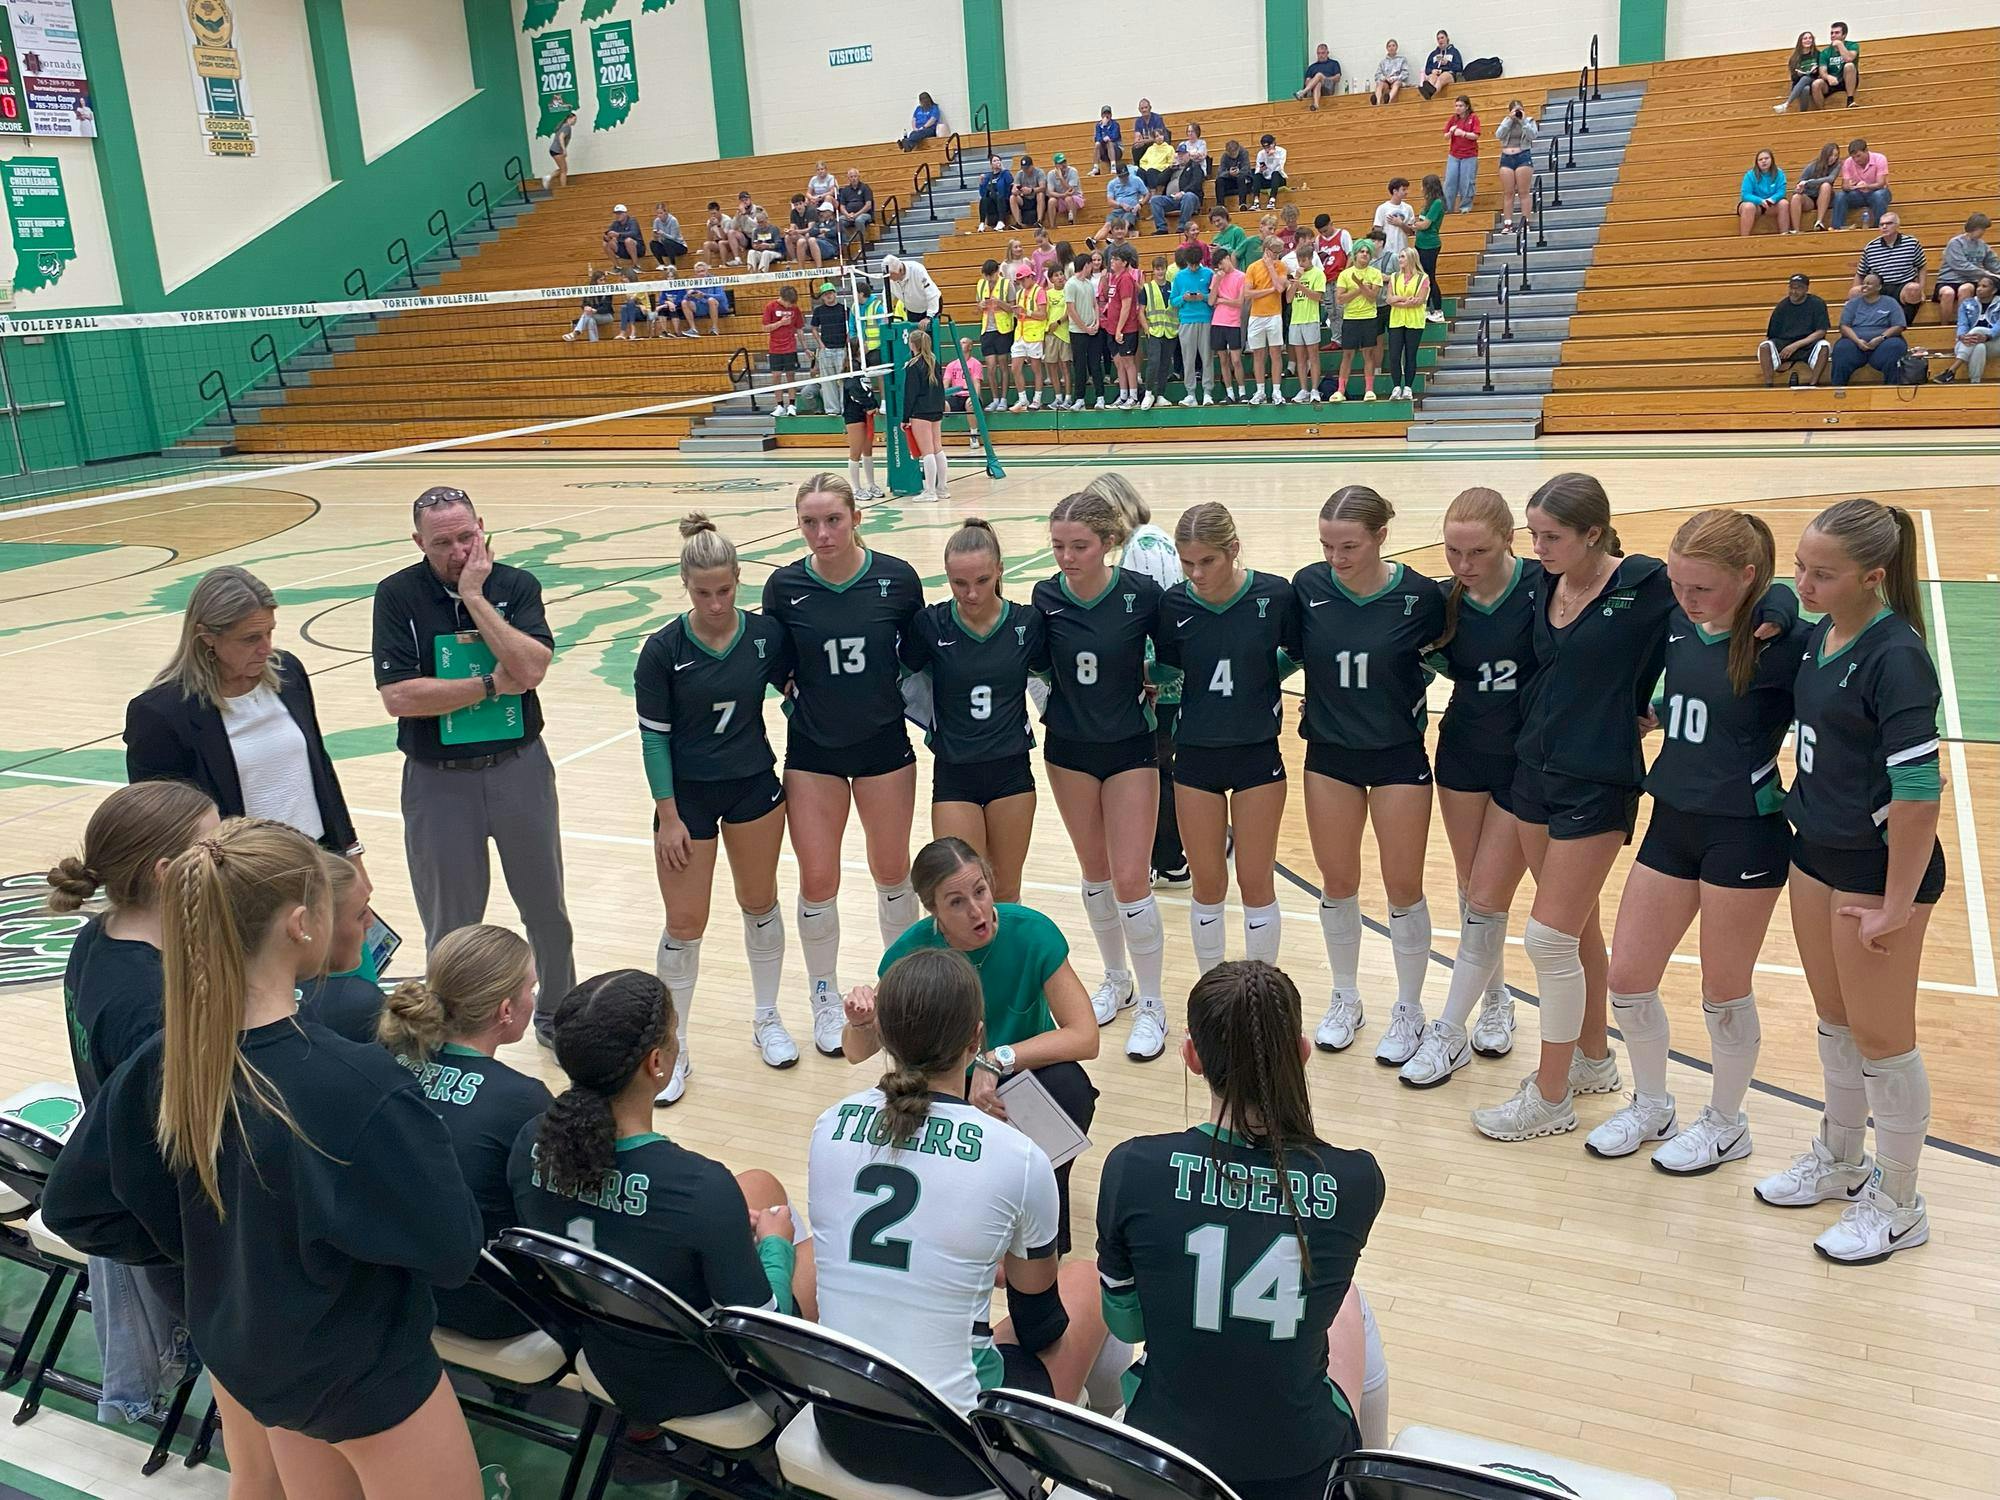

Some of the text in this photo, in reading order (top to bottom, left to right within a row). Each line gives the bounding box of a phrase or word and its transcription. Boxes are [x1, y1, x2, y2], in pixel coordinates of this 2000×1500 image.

[830, 46, 872, 65] VISITORS
[542, 72, 572, 92] 2022
[600, 63, 632, 84] 2024
[2, 96, 16, 118] 0
[0, 122, 24, 132] SCORE
[208, 121, 250, 130] 2003-2004
[212, 142, 253, 150] 2012-2013
[669, 276, 740, 288] YORKTOWN VOLLEYBALL
[774, 268, 834, 280] YORKTOWN VOLLEYBALL
[382, 294, 488, 308] YORKTOWN VOLLEYBALL
[541, 284, 626, 297] YORKTOWN VOLLEYBALL
[180, 304, 317, 322] YORKTOWN VOLLEYBALL
[10, 318, 98, 332] VOLLEYBALL
[878, 578, 891, 598] Y
[1123, 594, 1136, 613] Y
[1256, 598, 1272, 618] Y
[1403, 594, 1420, 616] Y
[1014, 625, 1027, 646] Y
[754, 638, 766, 659] Y
[823, 636, 866, 676] 13
[1075, 650, 1099, 686] 8
[1208, 658, 1234, 698] 4
[1335, 650, 1370, 690] 11
[1477, 659, 1519, 692] 12
[969, 685, 993, 721] 9
[712, 700, 737, 734] 7
[1668, 693, 1708, 744] 10
[1169, 1151, 1338, 1220] TIGERS
[848, 1162, 922, 1272] 2
[1184, 1222, 1309, 1341] 14
